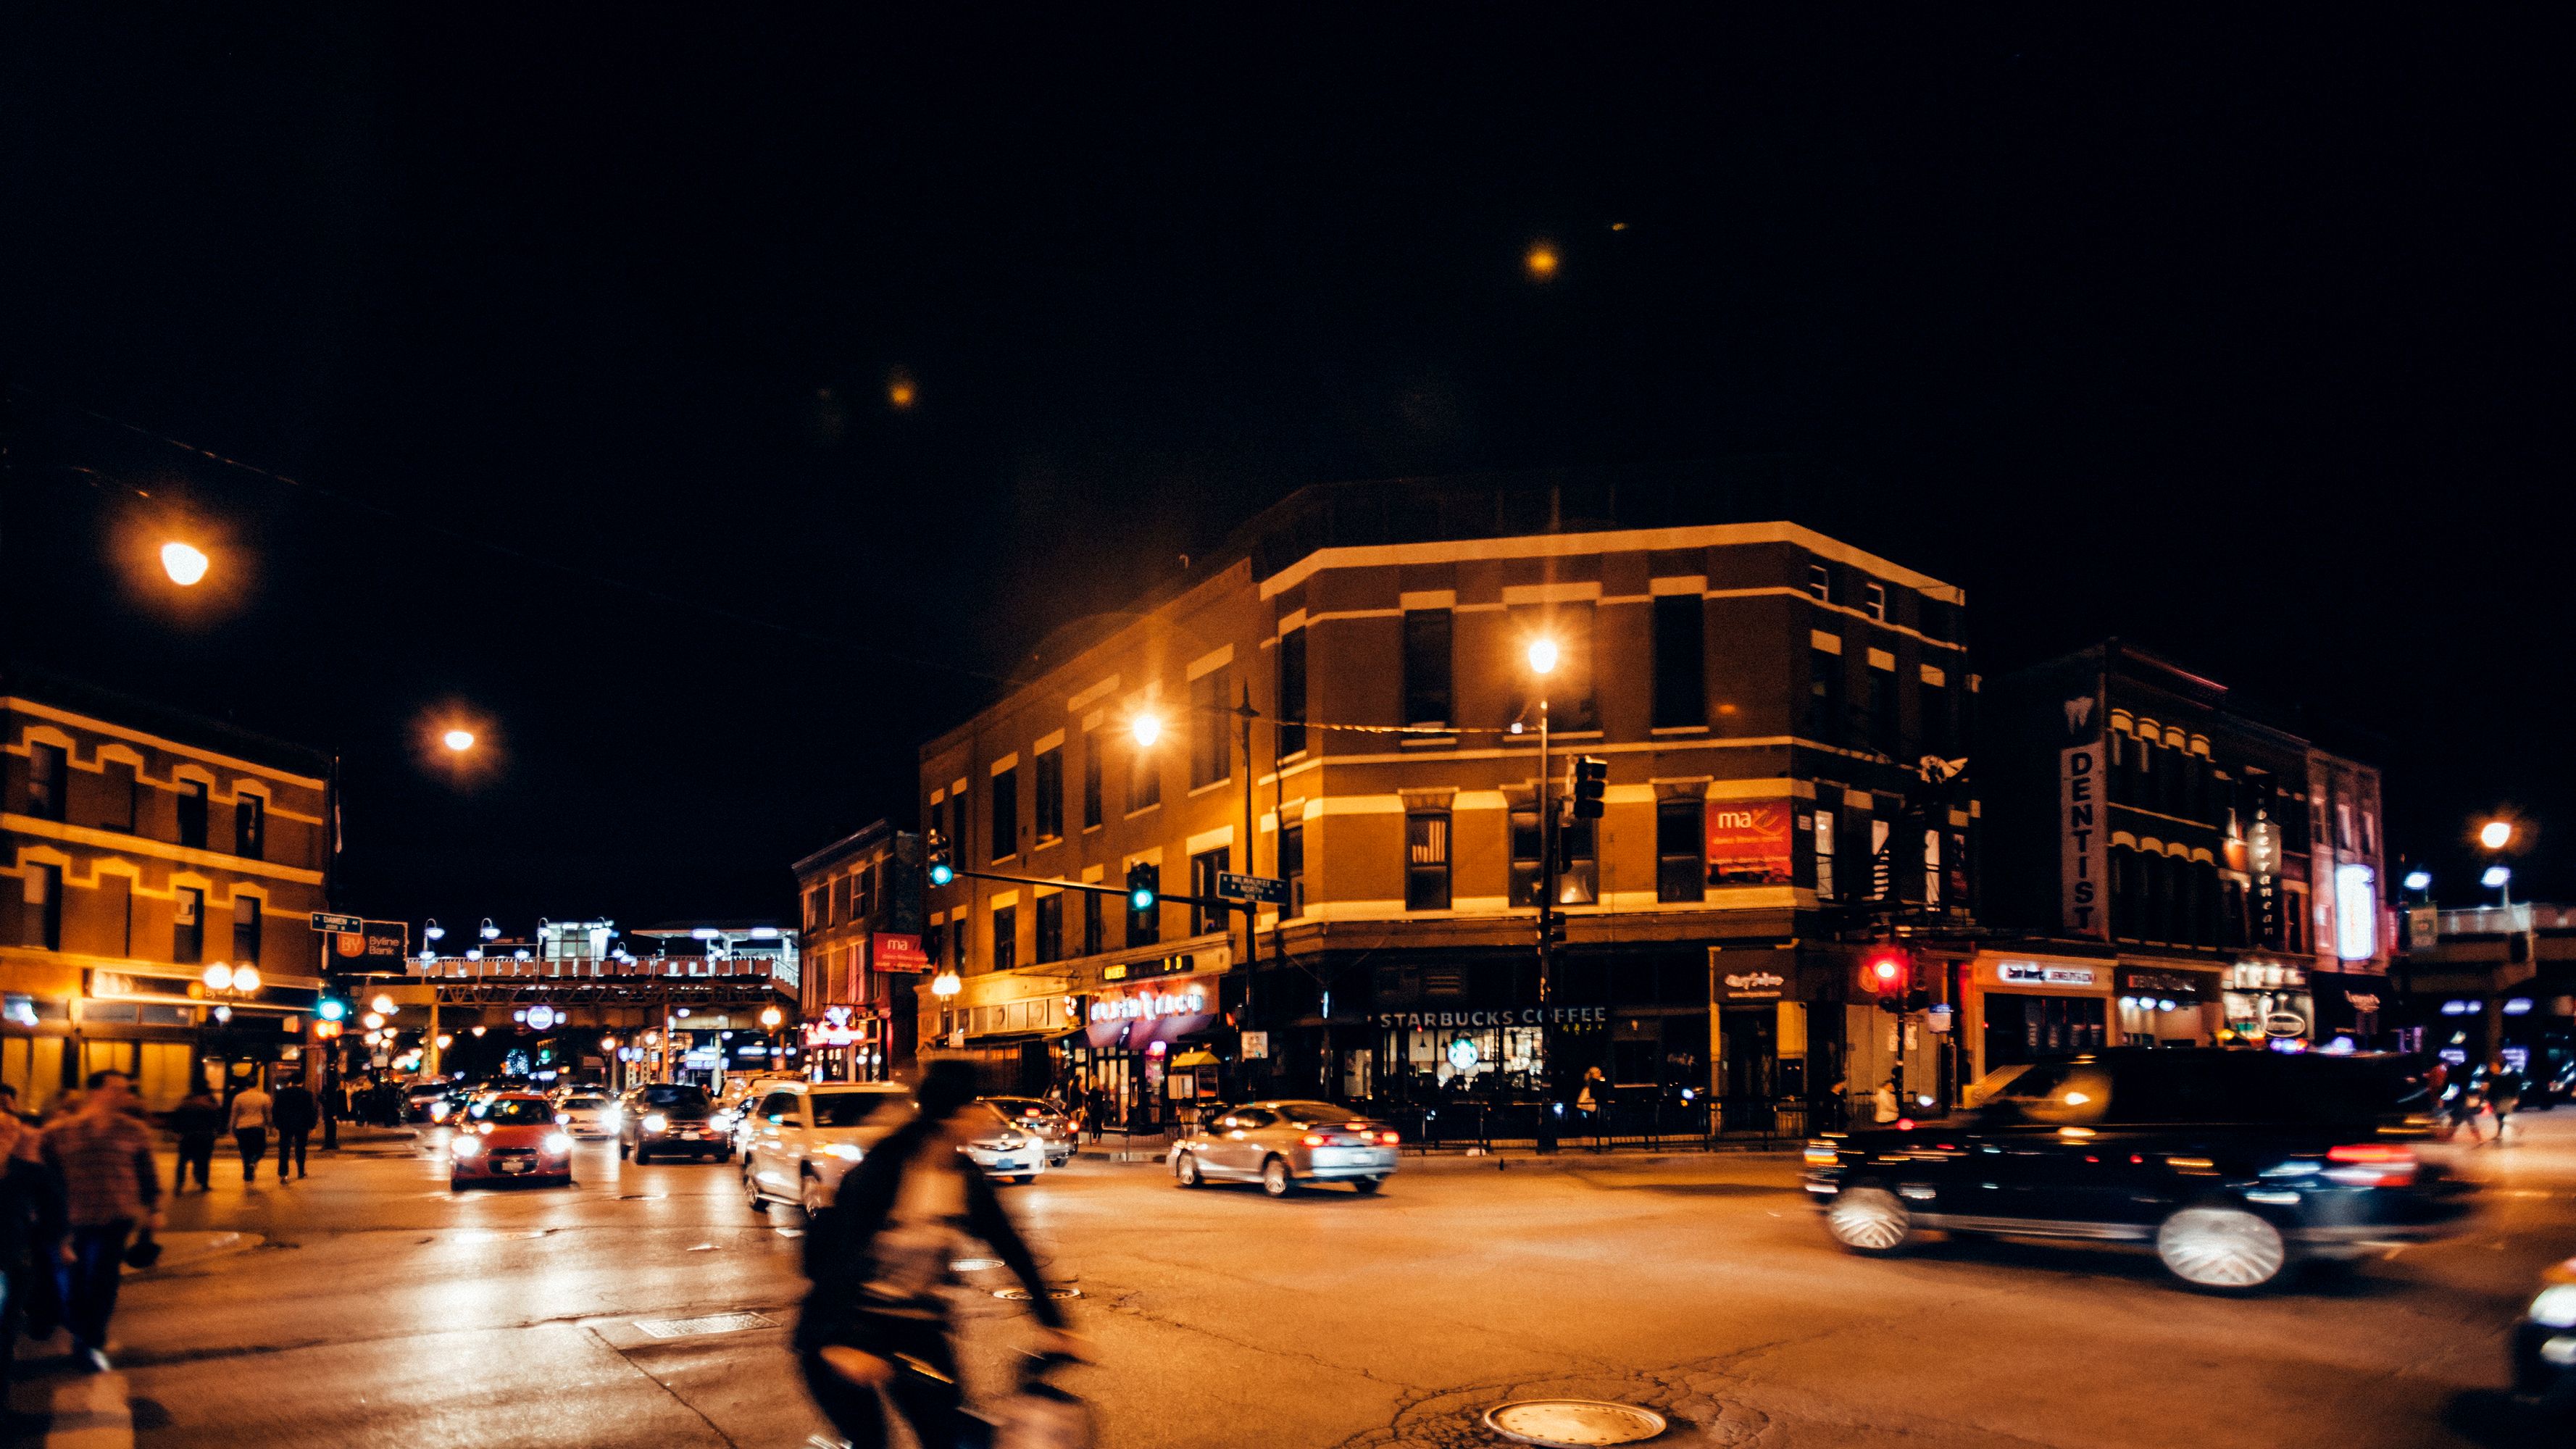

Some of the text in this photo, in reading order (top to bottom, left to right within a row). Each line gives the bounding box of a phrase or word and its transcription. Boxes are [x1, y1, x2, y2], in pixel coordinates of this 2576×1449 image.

[2071, 752, 2093, 929] DENTIST
[323, 915, 348, 925] DAMEN
[341, 936, 360, 951] BY
[369, 935, 399, 947] Byline
[369, 945, 394, 955] Bank
[1380, 1011, 1514, 1028] STARBUCKS
